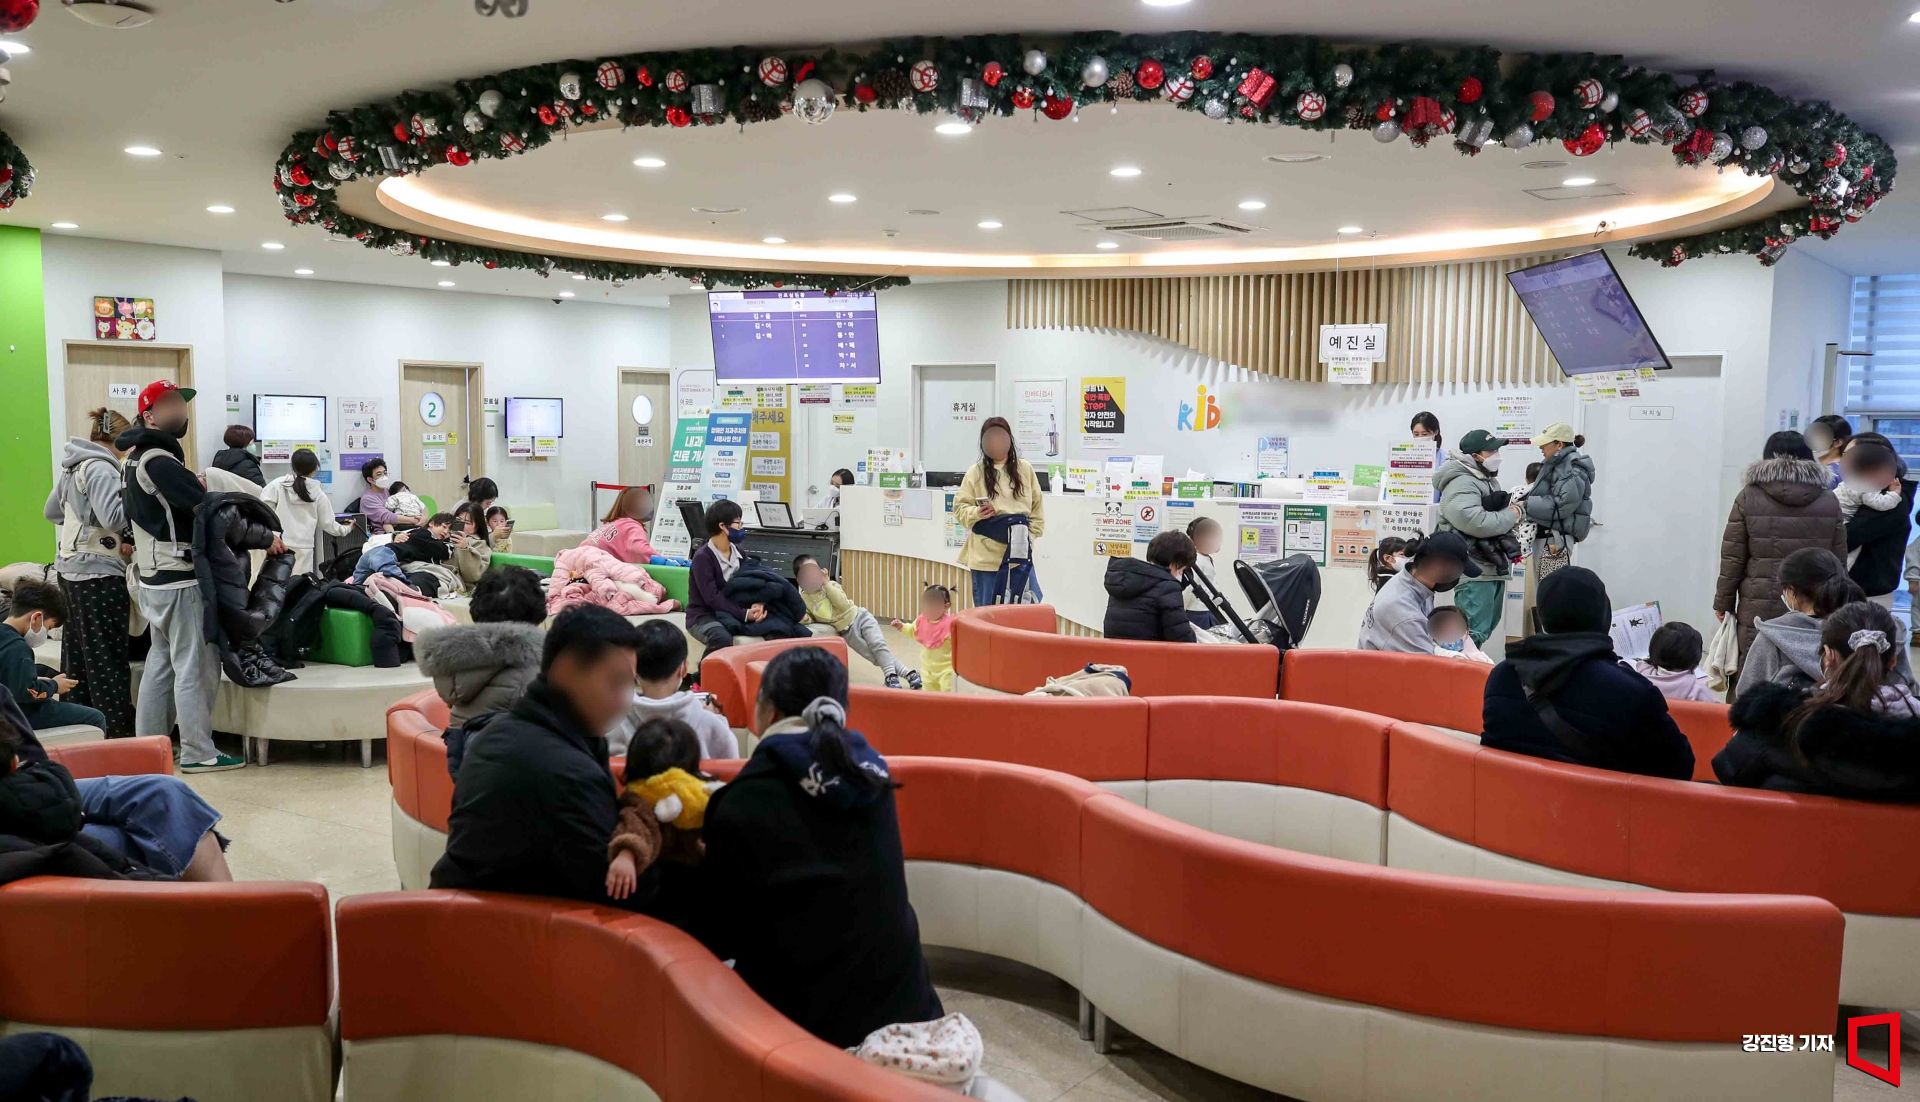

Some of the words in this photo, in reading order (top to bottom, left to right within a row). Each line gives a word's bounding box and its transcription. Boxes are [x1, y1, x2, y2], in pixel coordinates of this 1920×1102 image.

[1329, 335, 1376, 351] 예진실
[112, 387, 137, 396] 사무실
[428, 402, 436, 418] 2
[953, 402, 976, 412] 휴게실
[672, 450, 691, 462] 진료
